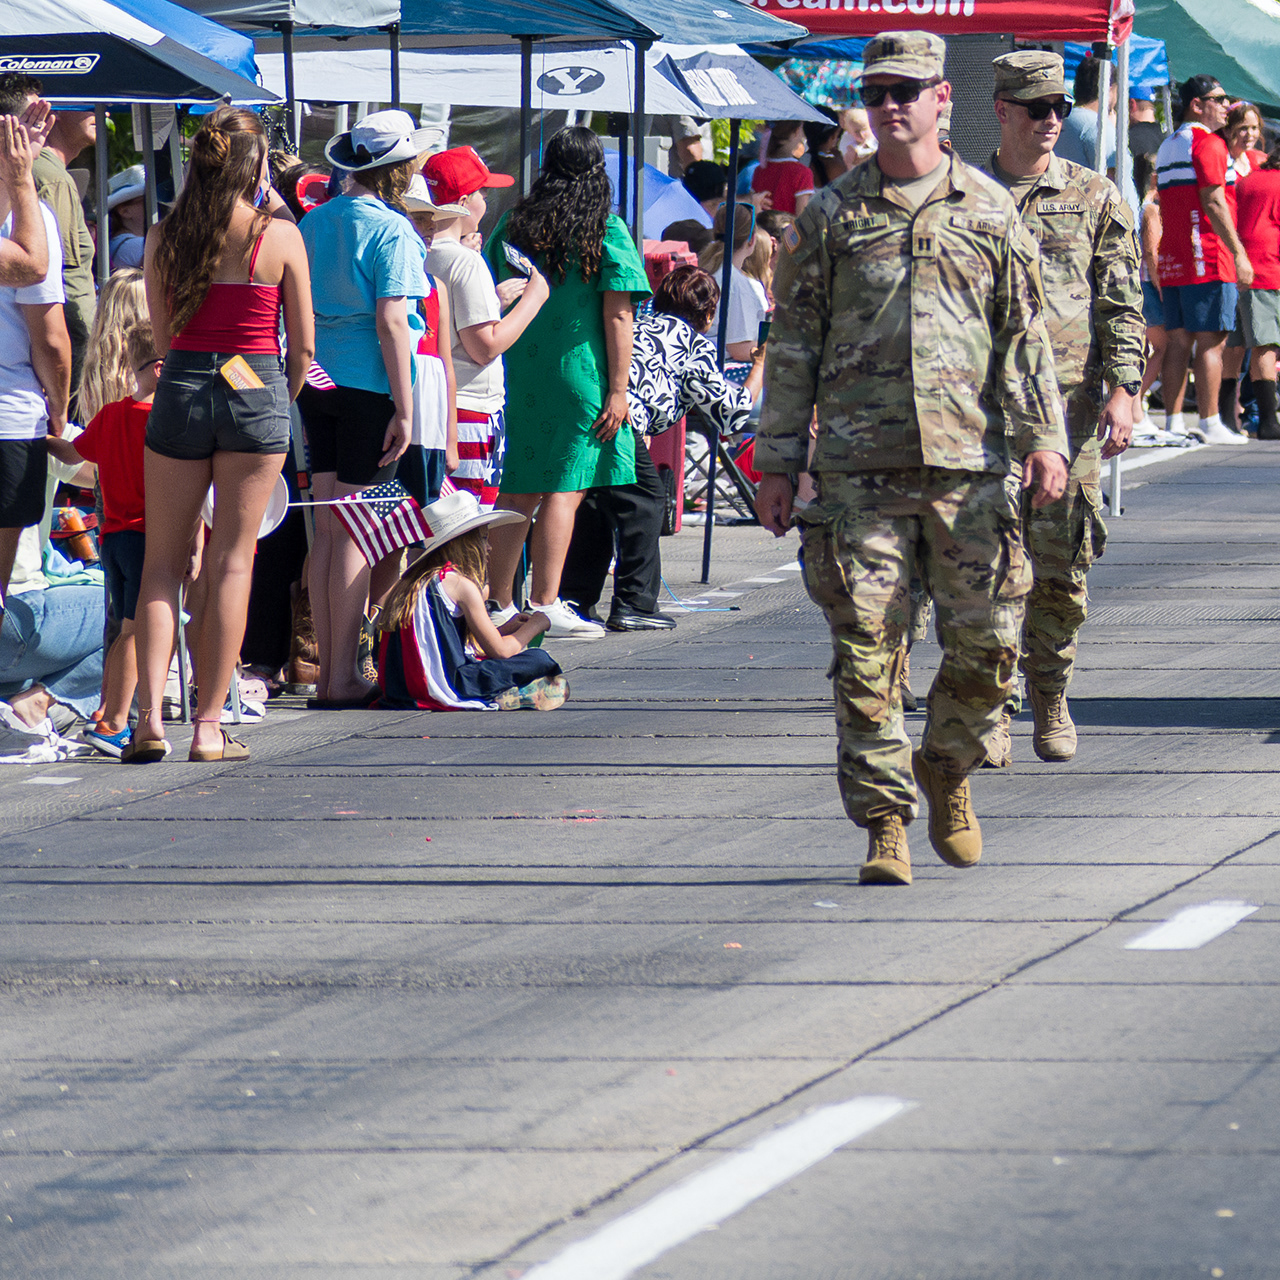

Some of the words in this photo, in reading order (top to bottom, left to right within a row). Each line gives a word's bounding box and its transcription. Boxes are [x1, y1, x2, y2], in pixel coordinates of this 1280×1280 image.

[0, 57, 74, 70] Coleman
[1042, 203, 1056, 211] U.S.
[1059, 203, 1081, 211] ARMY
